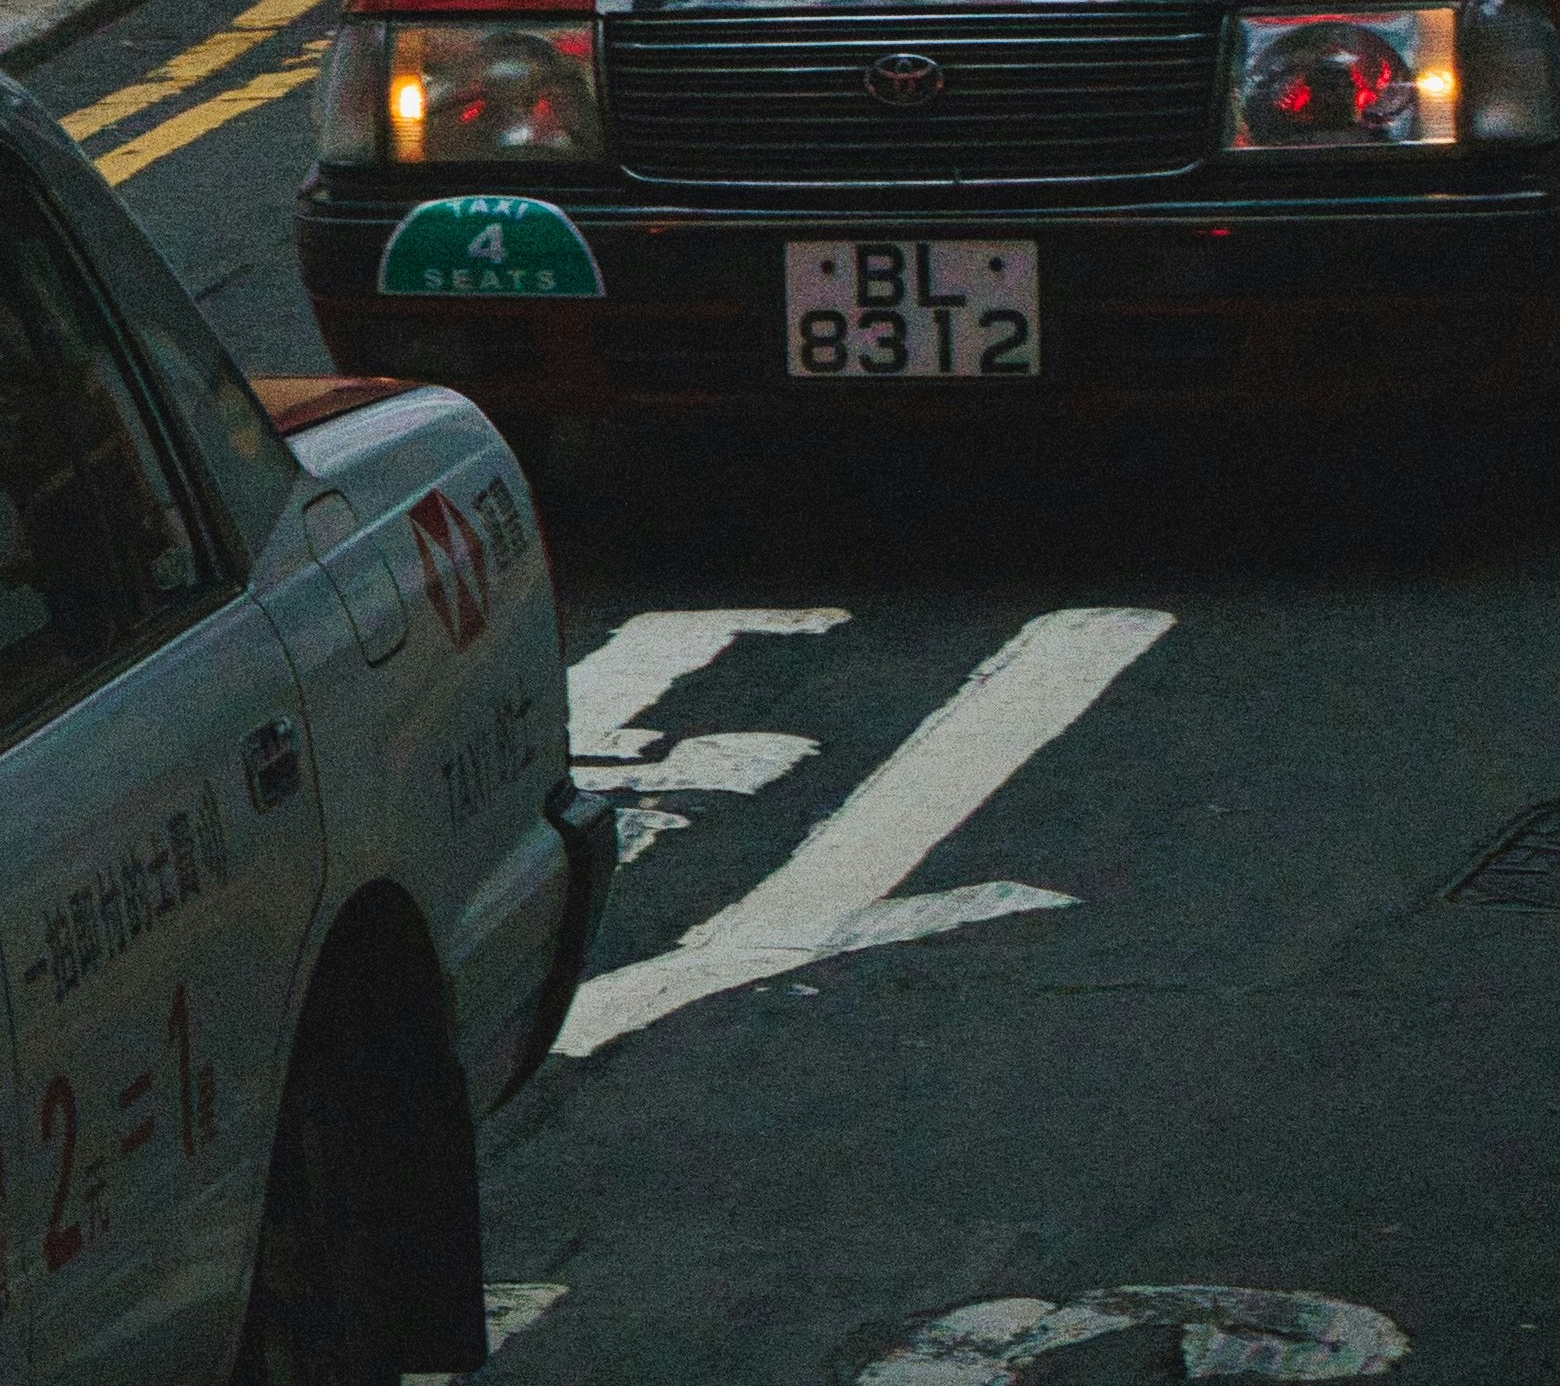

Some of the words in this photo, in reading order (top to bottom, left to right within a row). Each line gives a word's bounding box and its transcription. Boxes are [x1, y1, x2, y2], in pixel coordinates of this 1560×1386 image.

[445, 198, 529, 221] TAXI
[470, 222, 509, 264] 4
[423, 268, 556, 290] SEATS
[854, 242, 967, 307] BL
[799, 308, 1031, 374] 8312
